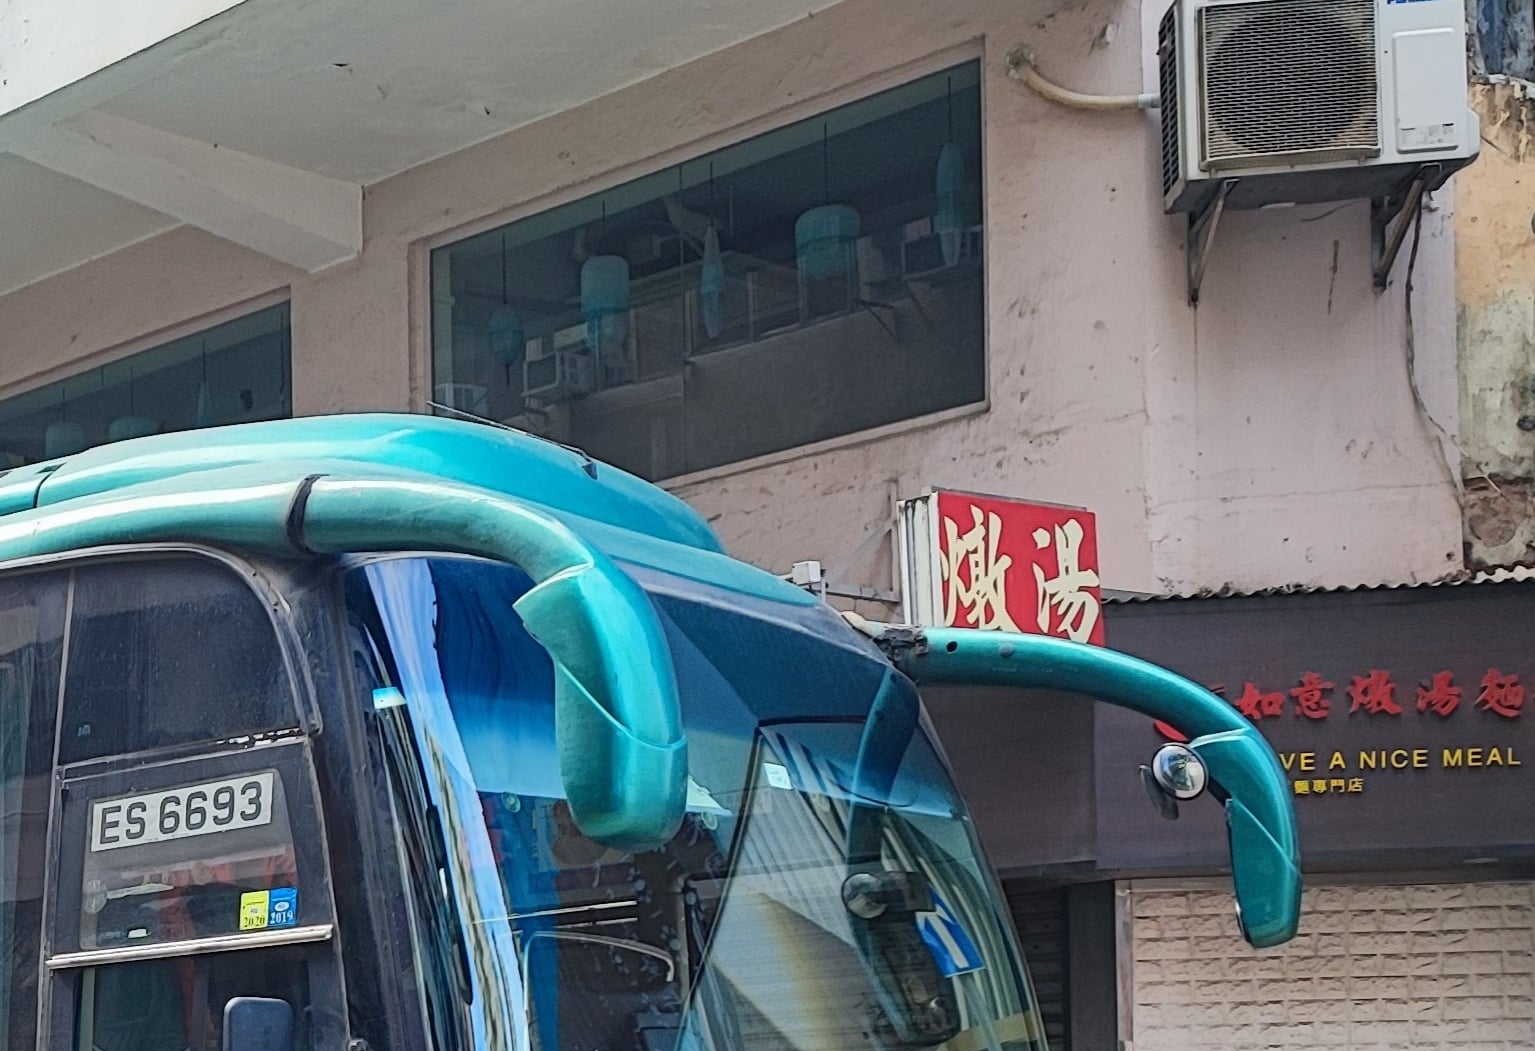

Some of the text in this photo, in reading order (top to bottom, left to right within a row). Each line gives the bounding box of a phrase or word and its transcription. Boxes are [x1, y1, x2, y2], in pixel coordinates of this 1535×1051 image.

[1209, 667, 1535, 720] 如意燉湯麵
[1280, 747, 1522, 772] VE A NICE MEAL
[1293, 778, 1364, 795] 麵專門店
[99, 780, 263, 845] ES 6693
[243, 914, 266, 929] 2020
[269, 910, 294, 925] 2019
